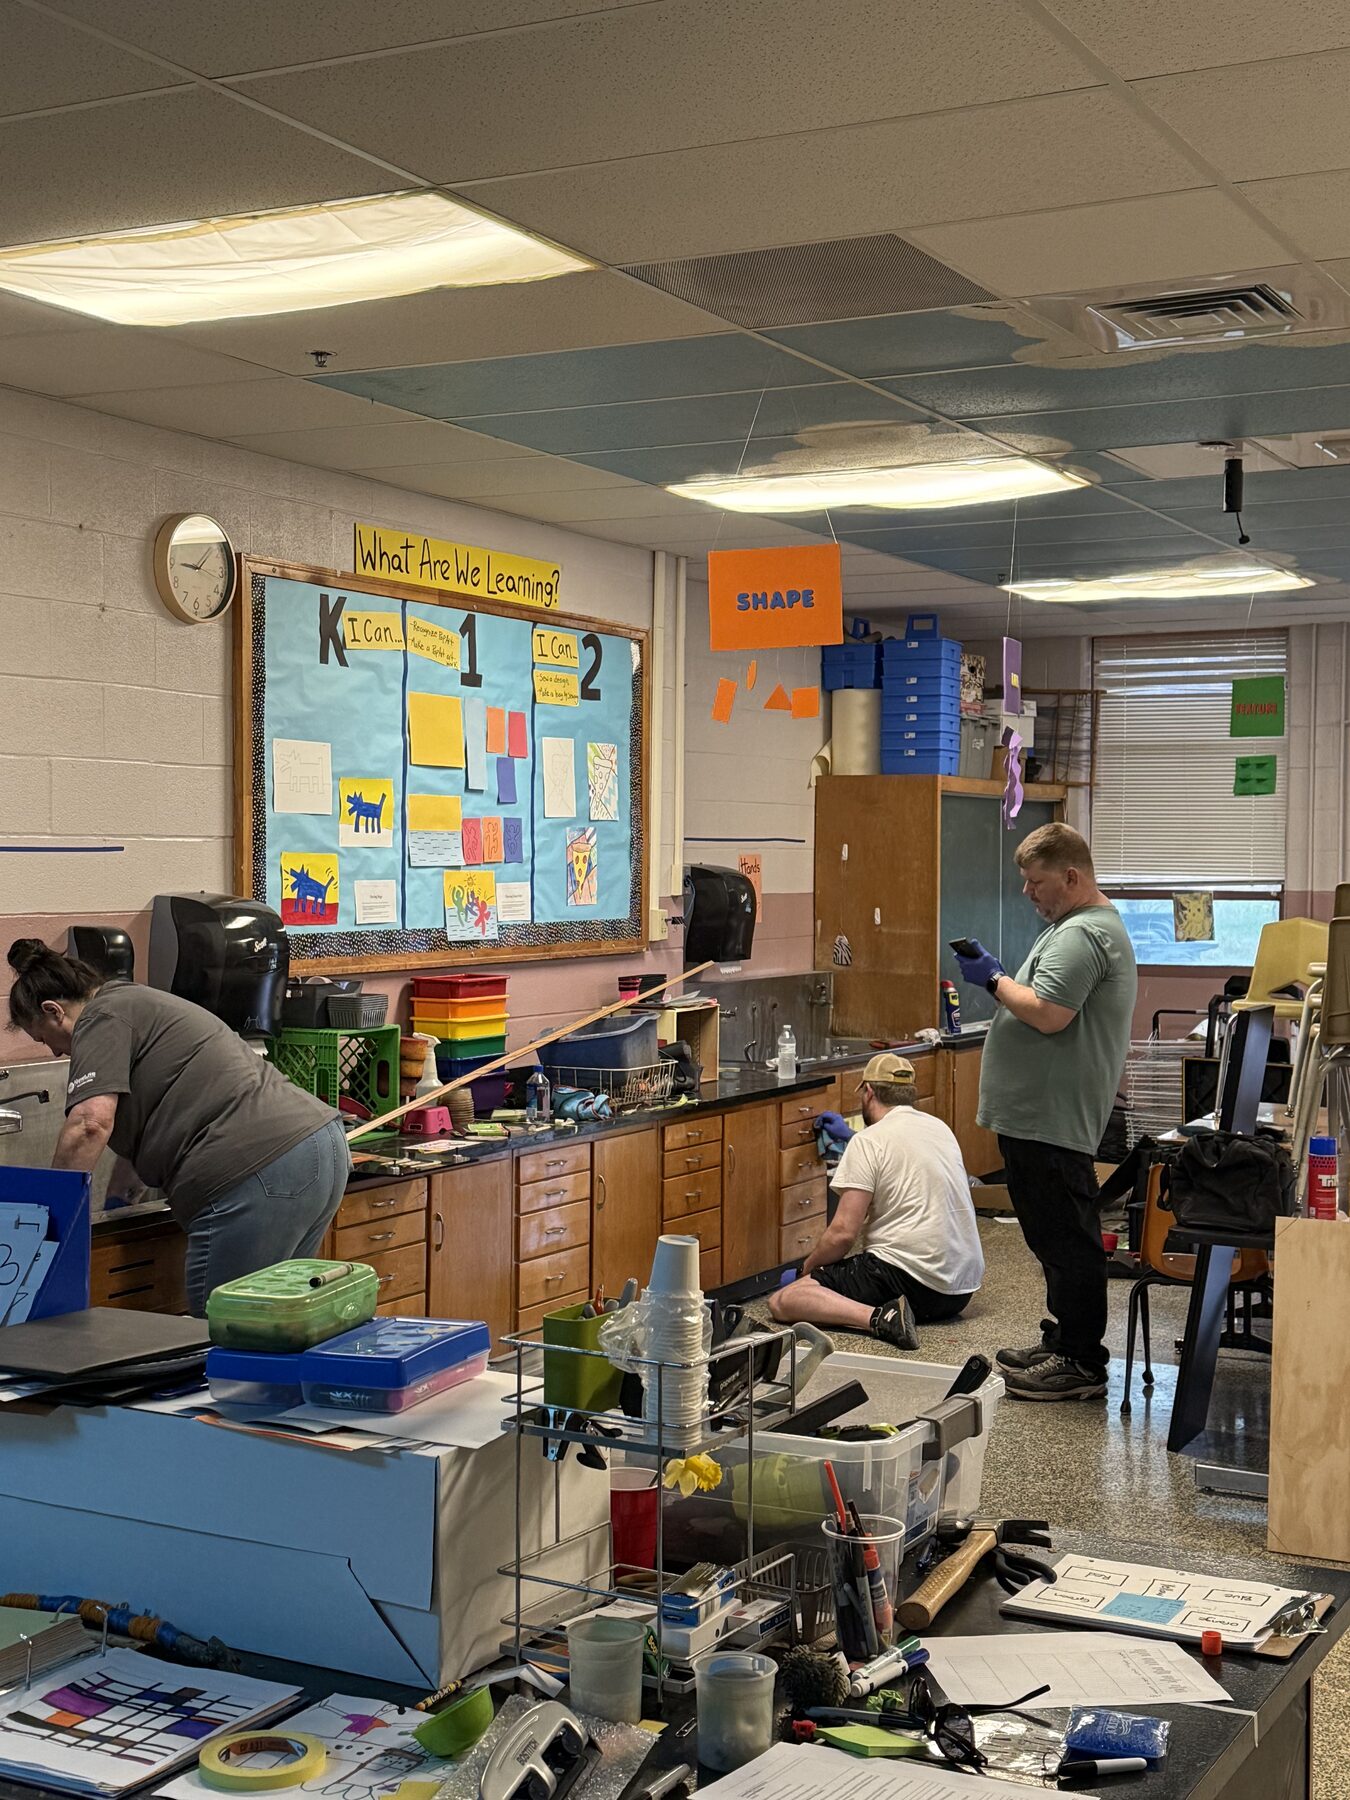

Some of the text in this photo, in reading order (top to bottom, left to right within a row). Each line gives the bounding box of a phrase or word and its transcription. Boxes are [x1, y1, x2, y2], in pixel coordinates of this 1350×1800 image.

[218, 566, 225, 579] 3
[358, 529, 560, 608] What Are We Learning?
[173, 575, 179, 589] 8
[213, 584, 219, 596] 4
[182, 590, 189, 604] 7
[193, 597, 200, 611] 6
[206, 595, 212, 608] 5
[736, 588, 815, 612] SHAPE
[319, 593, 349, 668] K
[347, 617, 361, 643] I
[459, 613, 483, 688] 1
[536, 633, 549, 658] I
[580, 633, 603, 701] 2
[1224, 1592, 1253, 1602] Blue
[515, 1738, 540, 1766] BOSTITCH
